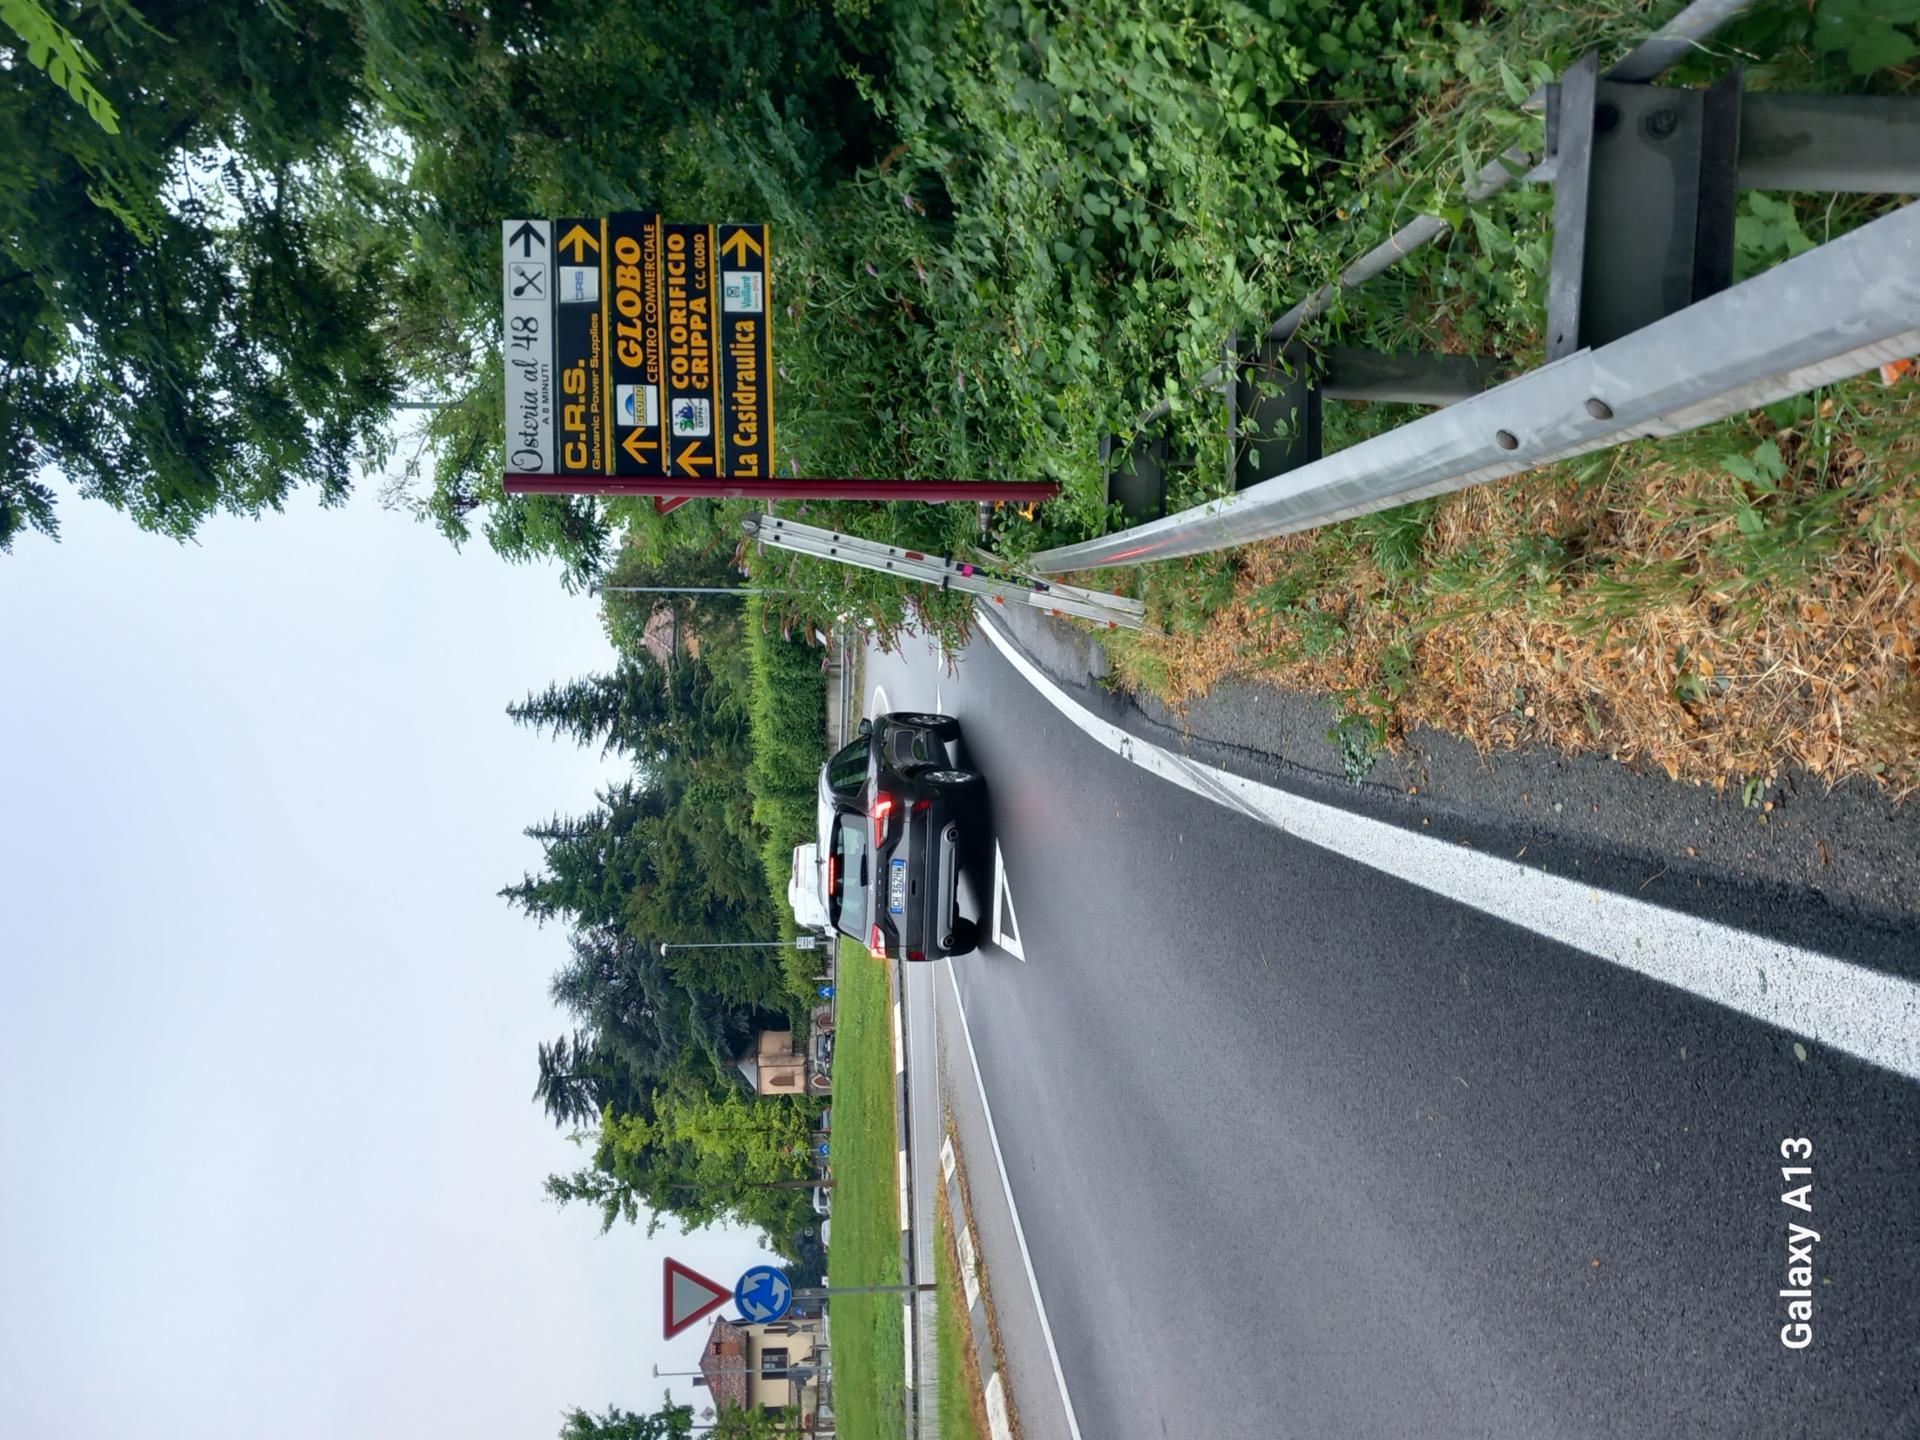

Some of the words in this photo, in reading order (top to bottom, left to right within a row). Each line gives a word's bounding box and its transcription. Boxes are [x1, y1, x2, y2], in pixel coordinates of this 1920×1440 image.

[694, 234, 706, 268] GLOBO
[575, 271, 584, 301] CRS
[644, 224, 657, 323] COMMERCIALE
[695, 271, 706, 289] C.C.
[741, 275, 751, 308] Vaillant
[614, 236, 643, 368] GLOBO
[667, 233, 689, 389] COLORIFICIO
[510, 316, 539, 351] 48
[589, 313, 600, 368] Supplies
[646, 327, 658, 383] CENTRO
[689, 296, 709, 389] CRIPPA
[511, 358, 538, 382] al
[541, 364, 549, 404] MINUTI
[590, 370, 600, 413] Power
[729, 321, 758, 447] Casidraulica
[542, 417, 550, 425] A
[563, 359, 587, 469] C.R.S.
[635, 386, 644, 424] GLOBO
[511, 389, 543, 472] Osteria
[591, 415, 601, 470] Galvanic
[734, 453, 758, 477] La
